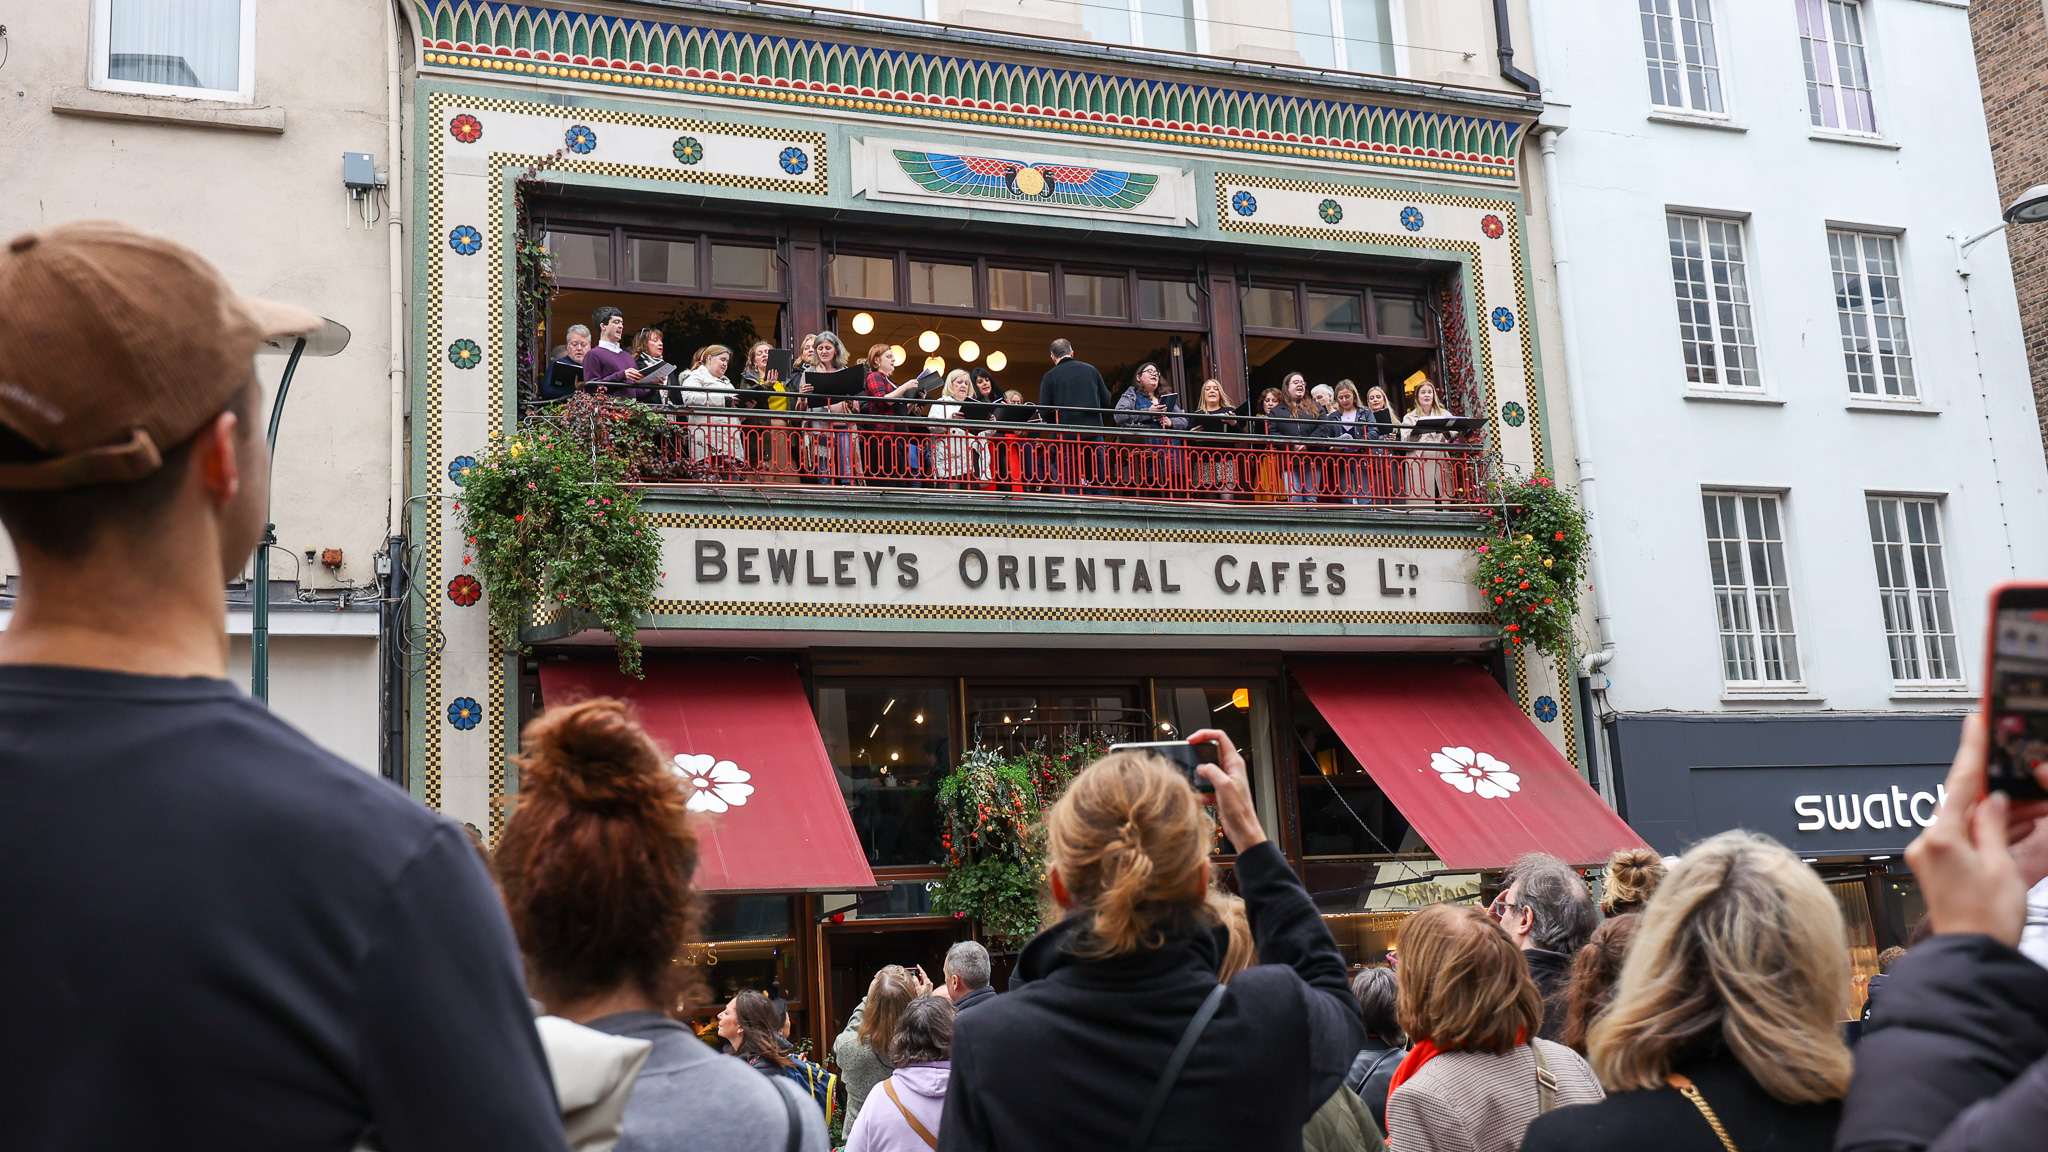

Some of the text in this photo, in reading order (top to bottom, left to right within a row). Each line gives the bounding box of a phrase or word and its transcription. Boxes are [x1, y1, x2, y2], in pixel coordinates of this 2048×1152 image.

[695, 539, 919, 587] BEWLEY'S
[959, 547, 1181, 592] ORIENTAL
[1214, 554, 1346, 595] CAFÉS
